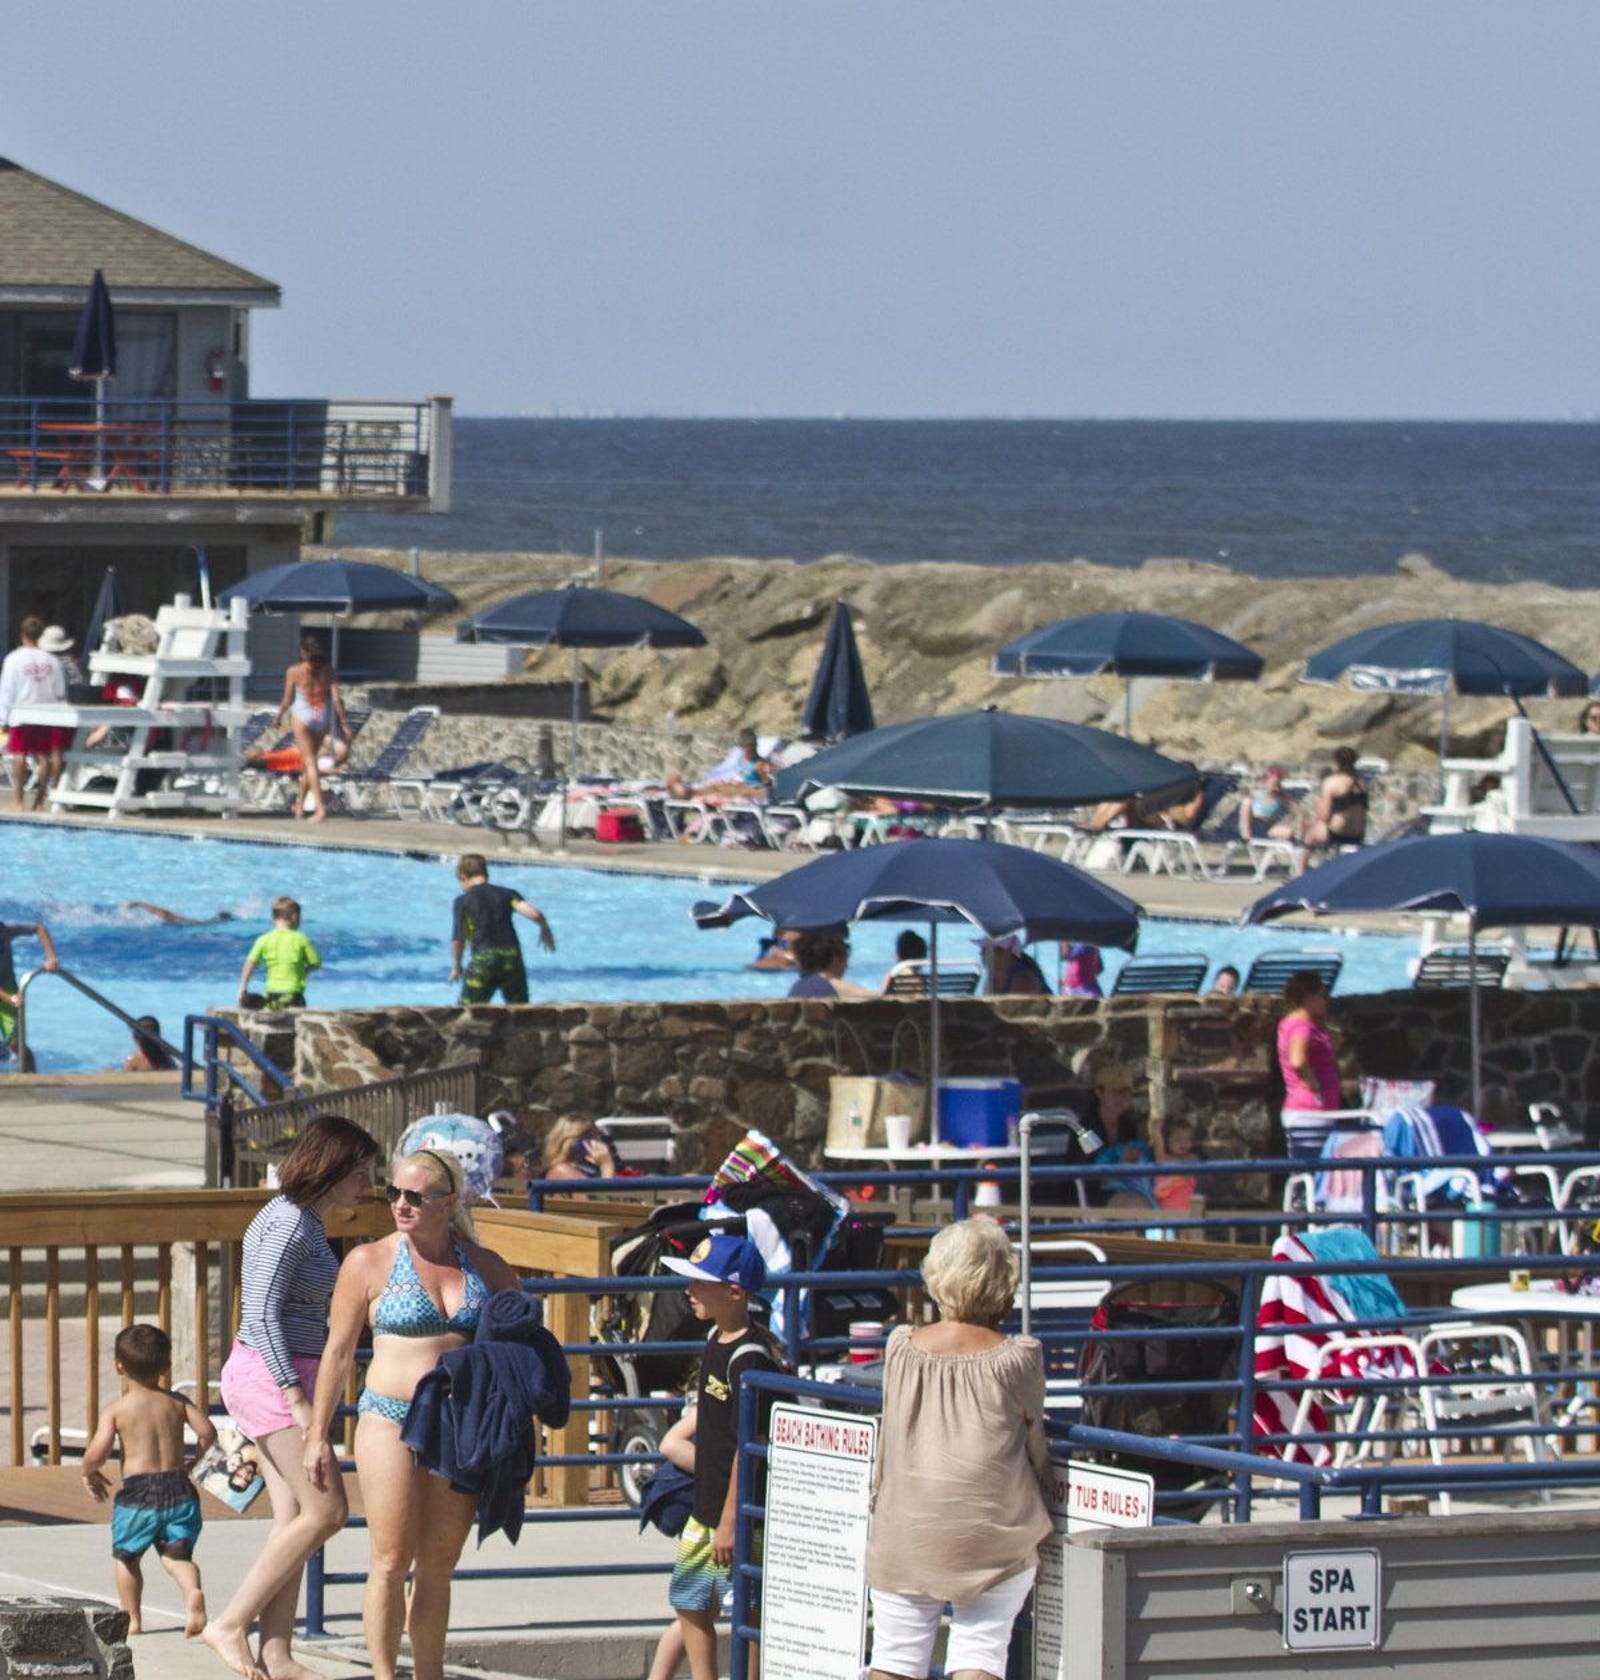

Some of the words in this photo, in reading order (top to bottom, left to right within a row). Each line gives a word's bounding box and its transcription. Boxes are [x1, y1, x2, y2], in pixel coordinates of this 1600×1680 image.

[776, 1417, 802, 1445] BEACH
[805, 1421, 840, 1451] BATHING
[842, 1427, 870, 1456] RULES
[1076, 1485, 1098, 1509] TUB
[1102, 1490, 1140, 1518] RULES
[1309, 1568, 1355, 1594] SPA
[1293, 1605, 1371, 1633] START
